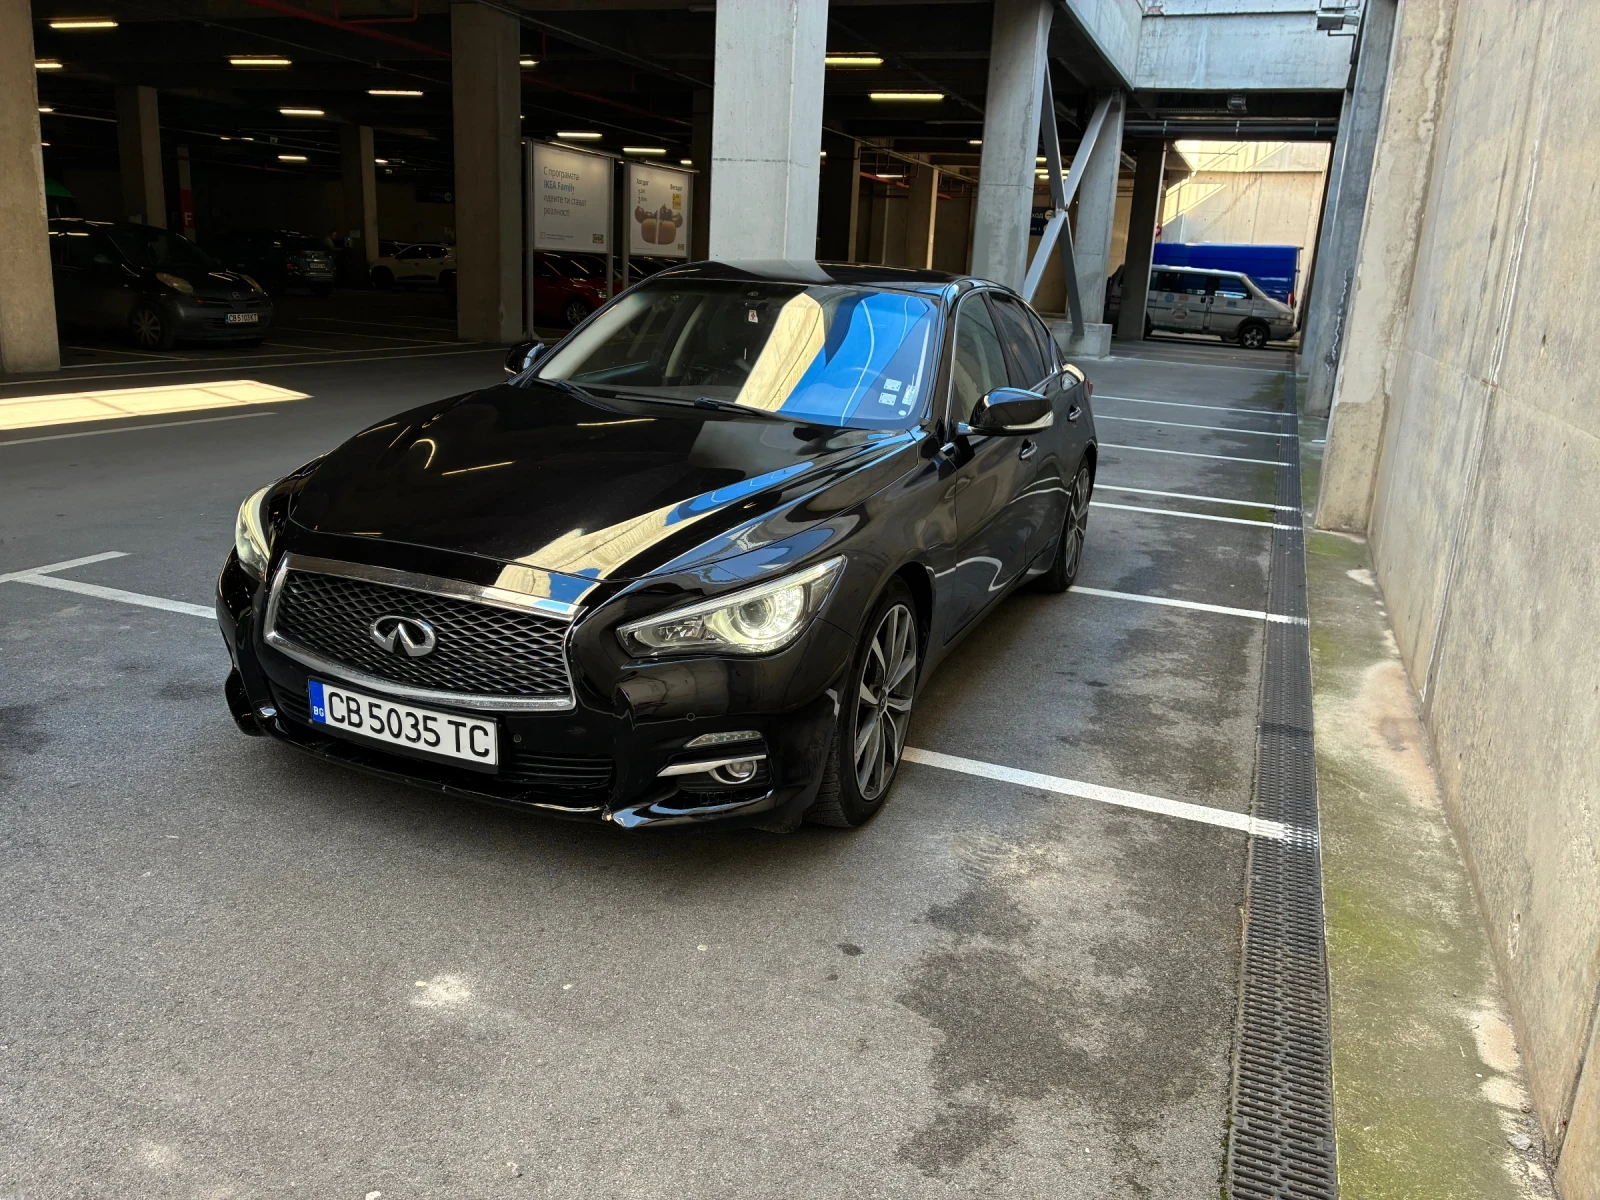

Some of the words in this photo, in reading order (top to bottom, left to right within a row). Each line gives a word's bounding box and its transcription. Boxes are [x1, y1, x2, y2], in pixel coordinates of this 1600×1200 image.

[549, 168, 580, 181] програмата
[543, 179, 557, 190] IKEA
[558, 181, 575, 195] Family
[543, 194, 564, 204] идеите
[564, 197, 571, 205] ти
[571, 198, 587, 207] стават
[184, 211, 193, 227] F
[229, 314, 237, 322] CB
[313, 705, 325, 717] BG
[328, 691, 364, 729] CB
[368, 701, 441, 748] 5035
[447, 719, 490, 758] TC
